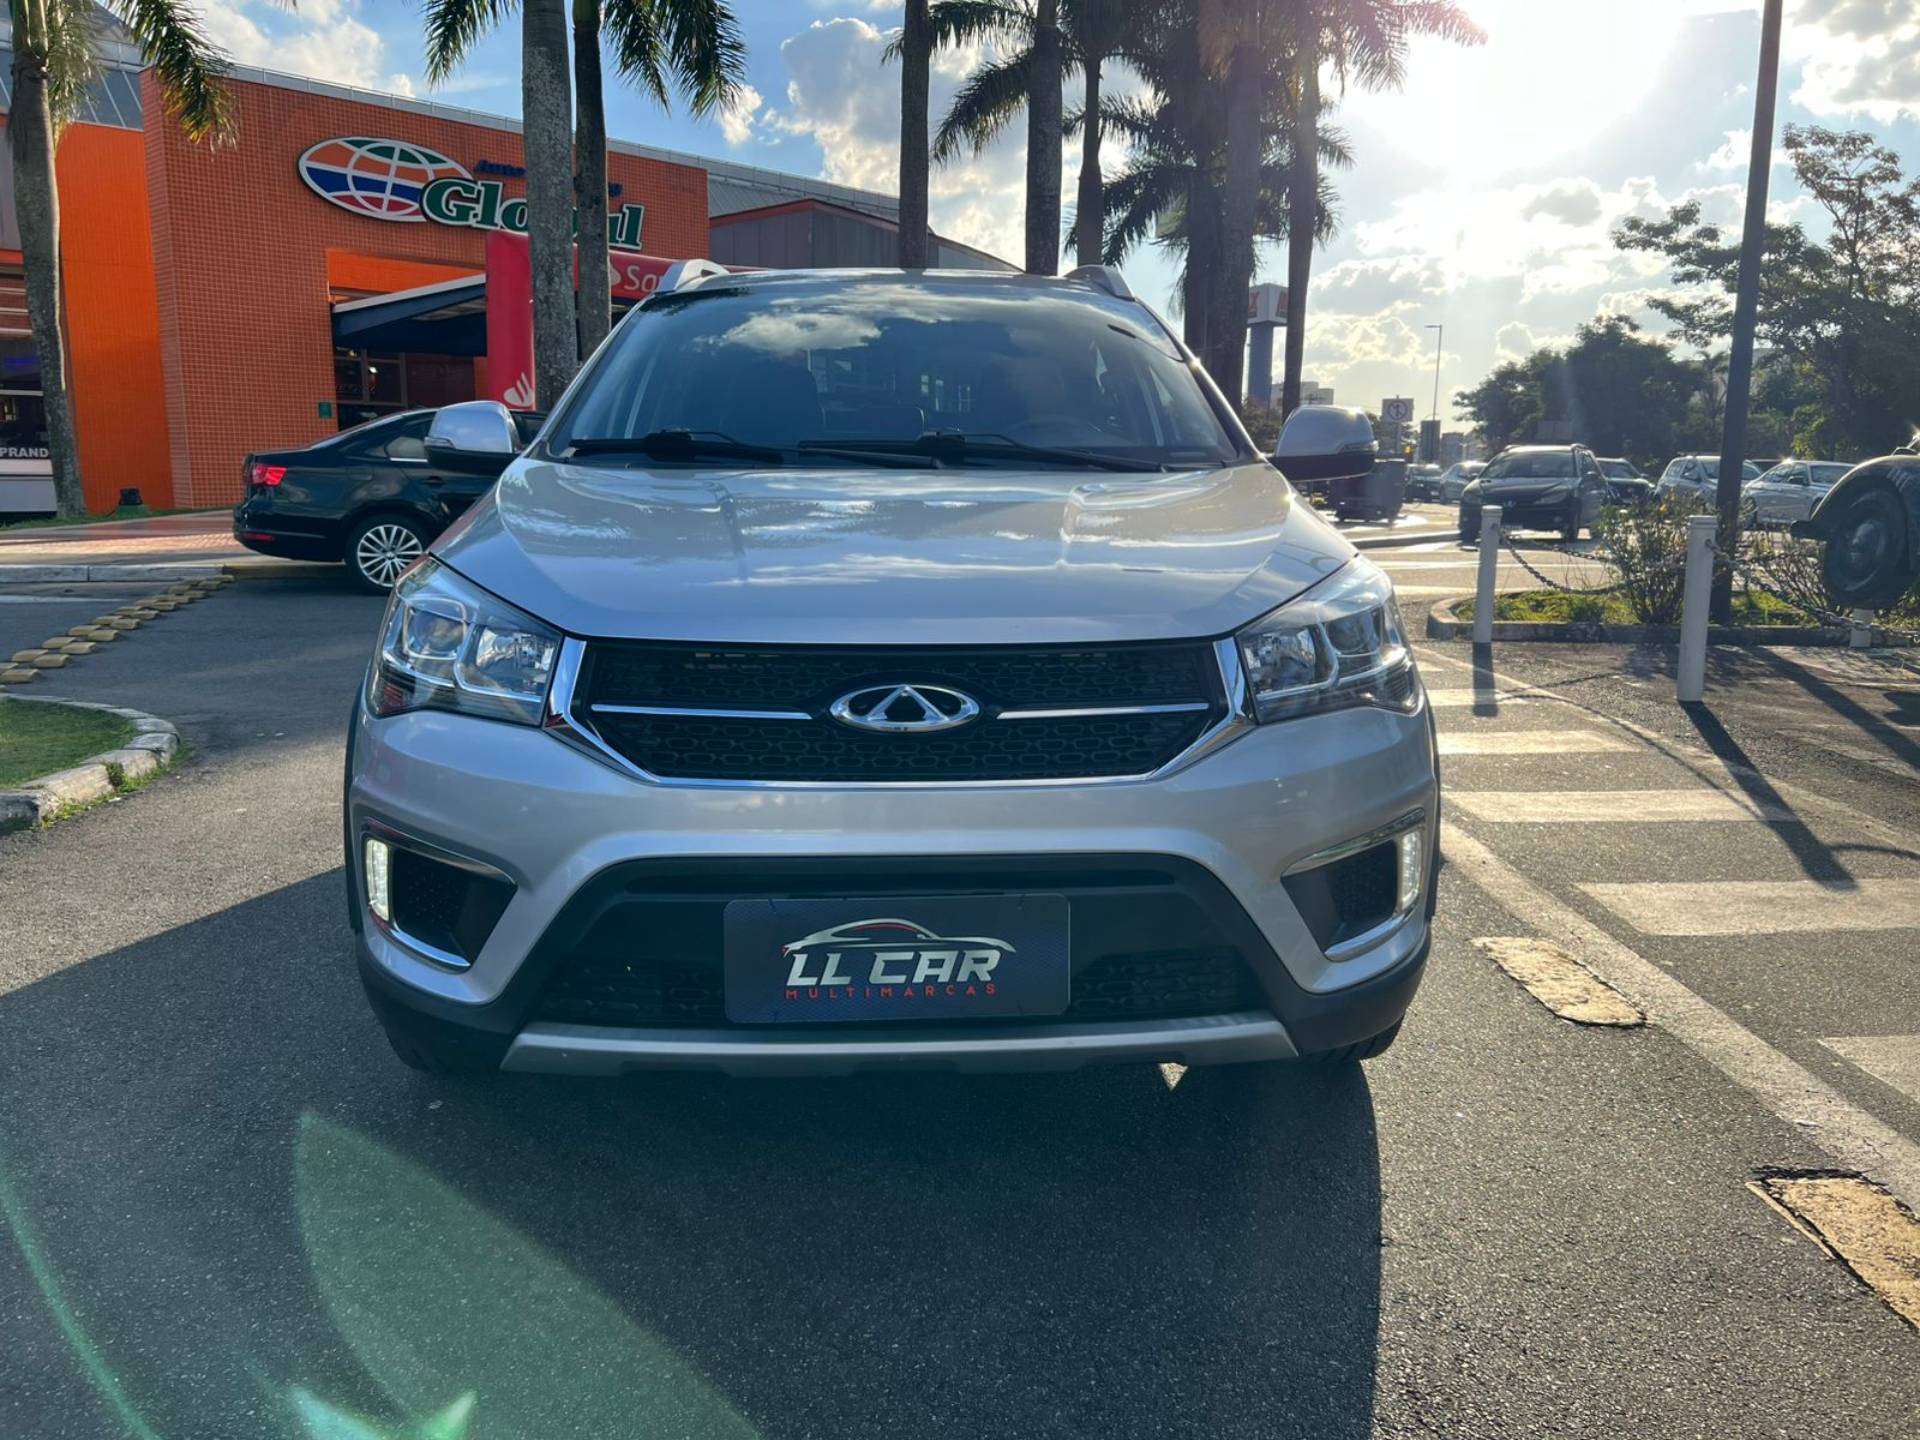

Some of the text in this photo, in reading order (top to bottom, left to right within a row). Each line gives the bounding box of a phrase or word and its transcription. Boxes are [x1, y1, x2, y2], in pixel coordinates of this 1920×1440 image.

[422, 177, 645, 250] Glol
[786, 949, 1001, 986] LL CAR
[785, 983, 996, 1000] MULTIMARCAS
